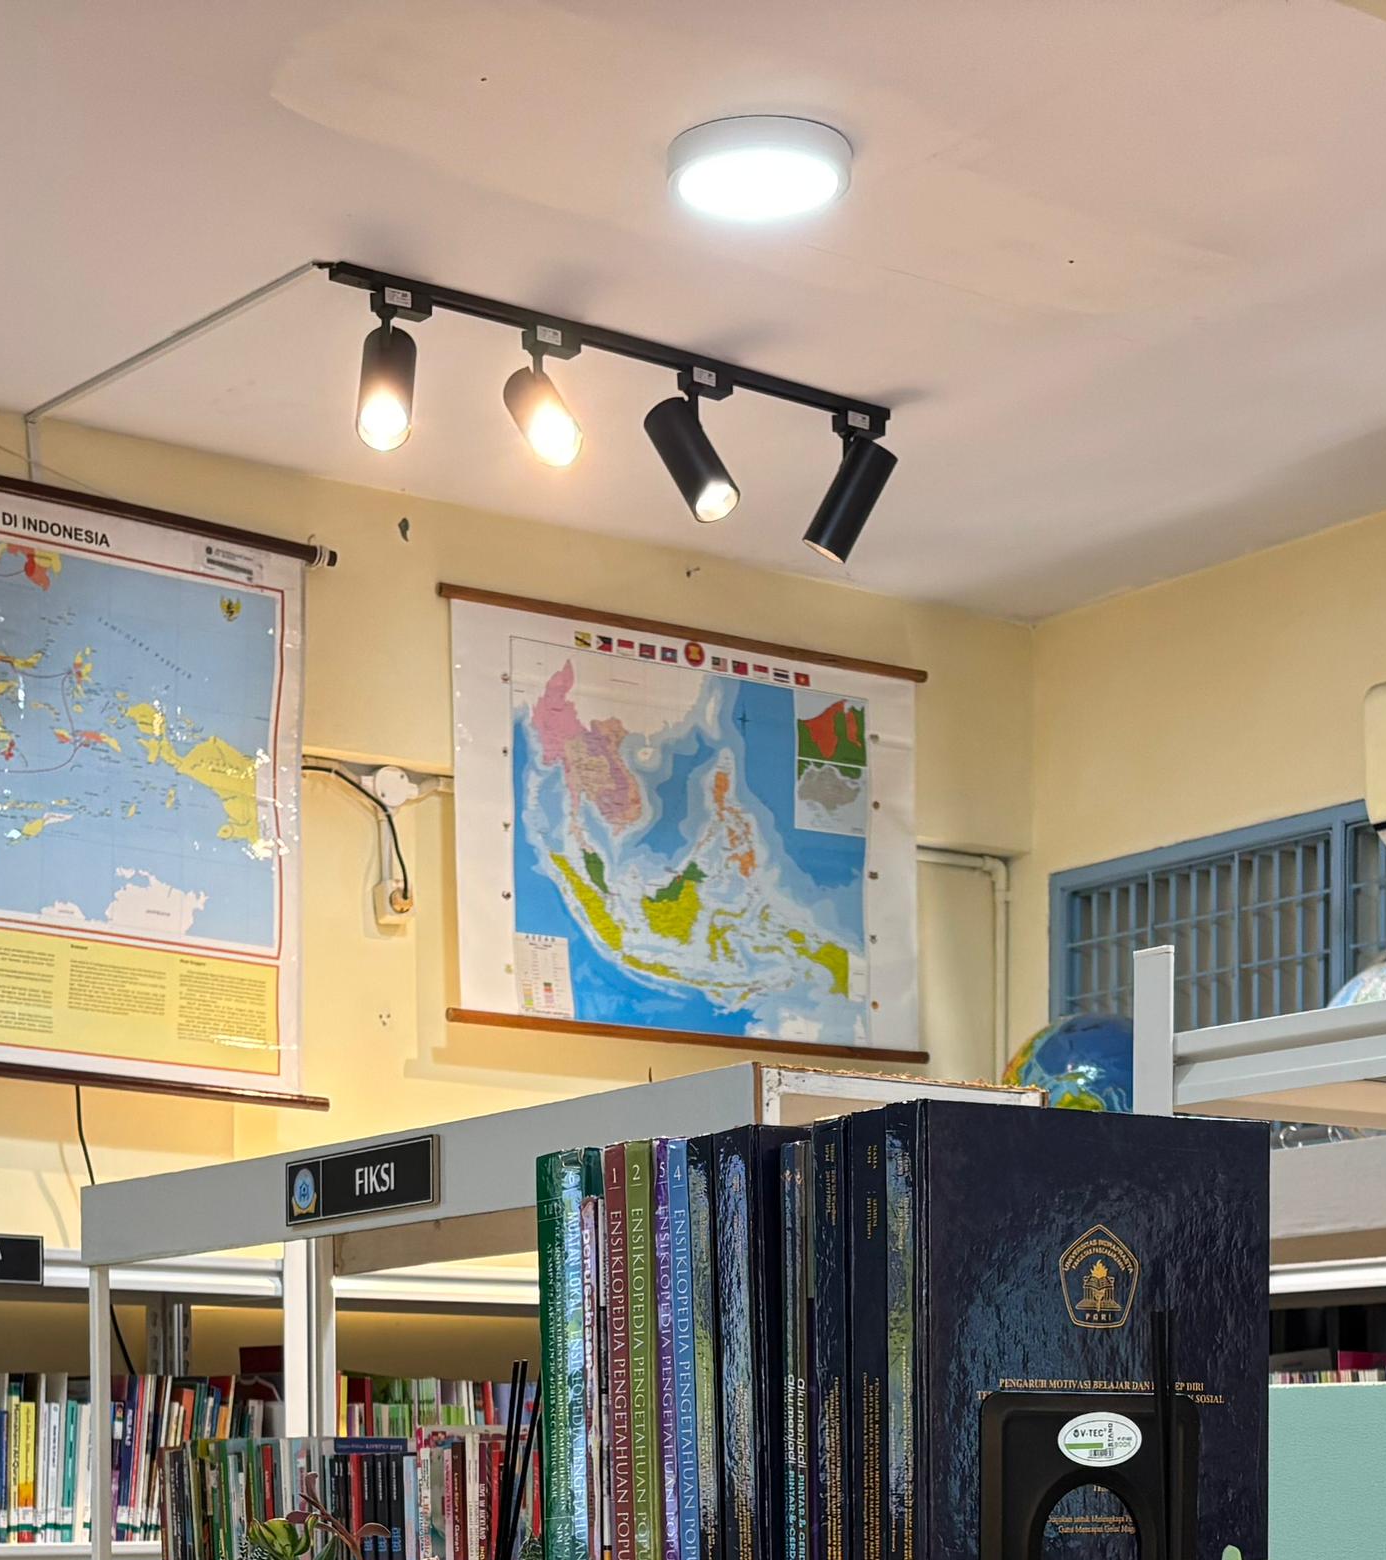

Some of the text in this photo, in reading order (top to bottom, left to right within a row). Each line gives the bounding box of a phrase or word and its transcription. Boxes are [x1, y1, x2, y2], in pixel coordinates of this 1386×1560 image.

[2, 511, 19, 527] DI
[22, 516, 111, 548] INDONESIA
[355, 1161, 395, 1197] FIKSI
[568, 1278, 582, 1314] LOKAL
[609, 1210, 626, 1351] ENSIKLOPEDIA
[631, 1208, 645, 1350] ENSIKLOPEDIA
[660, 1205, 672, 1348] ENSIKLOPEDIA
[674, 1209, 690, 1352] ENSIKLOPEDIA
[614, 1358, 629, 1503] PENGETAHUAN
[633, 1356, 646, 1503] PENGETAHUAN
[662, 1356, 678, 1503] PENGETAHUAN
[679, 1360, 696, 1509] PENGETAHUAN
[999, 1378, 1150, 1391] PENGARUH MOTIVASI BELAJAR DAN
[1186, 1382, 1205, 1392] DIRI
